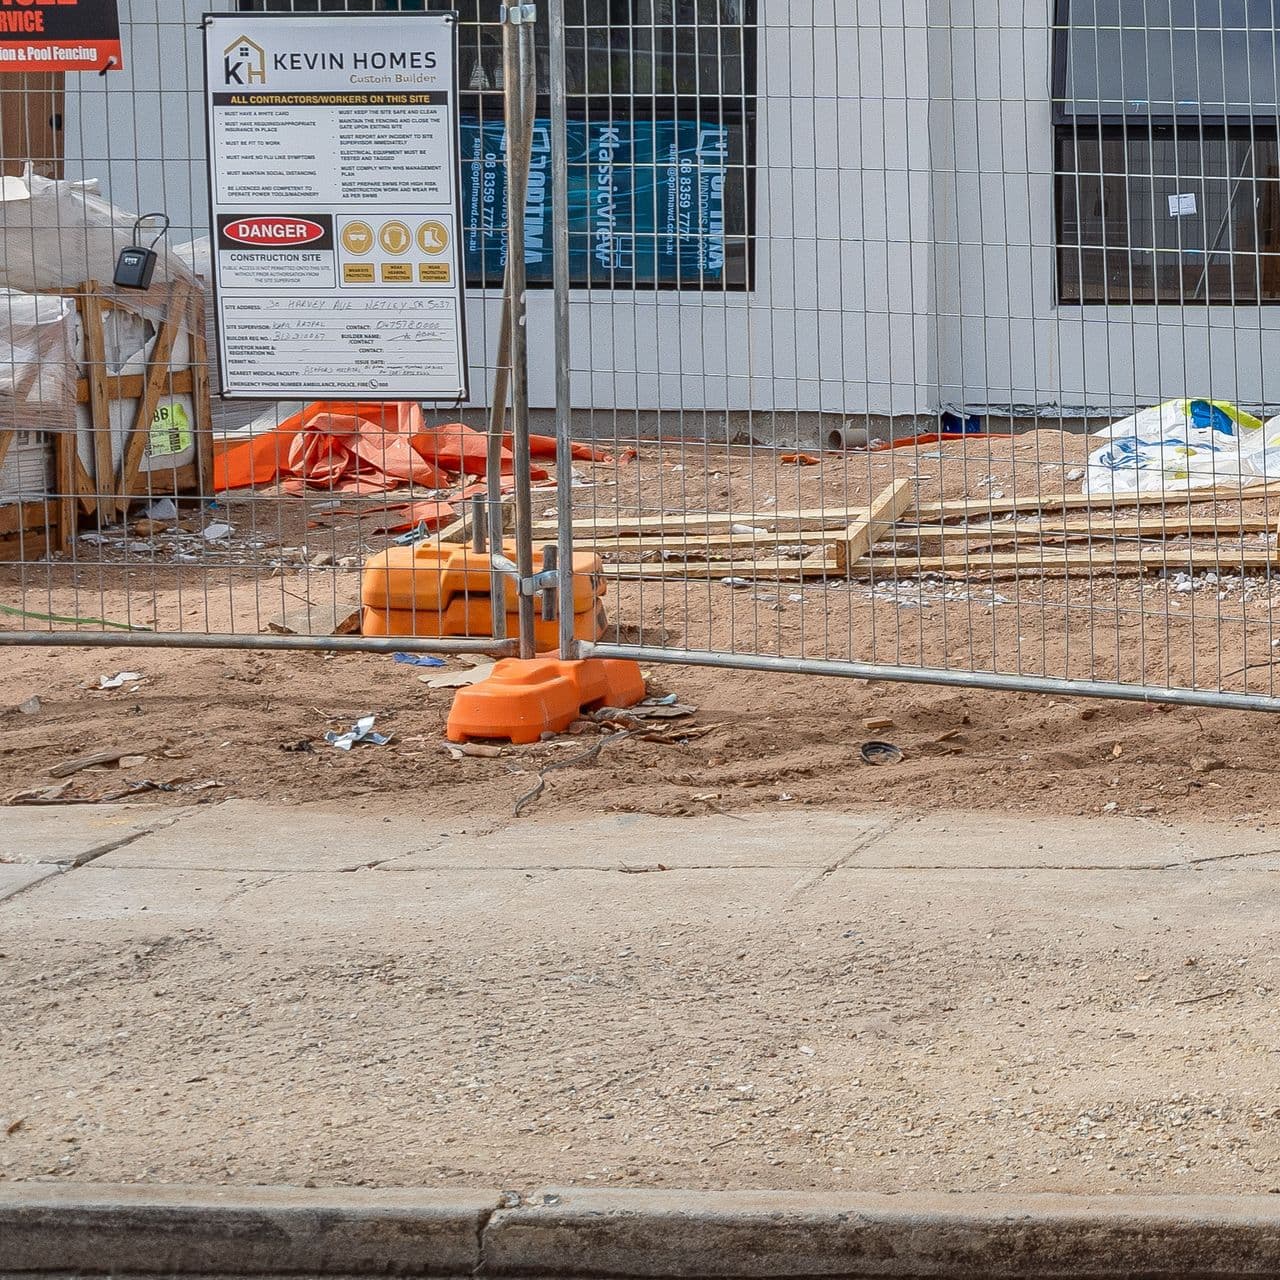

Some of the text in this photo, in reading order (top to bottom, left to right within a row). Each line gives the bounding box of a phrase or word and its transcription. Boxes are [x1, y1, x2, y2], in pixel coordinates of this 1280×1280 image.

[18, 47, 26, 62] &
[27, 46, 51, 62] Pool
[53, 46, 97, 63] Fencing
[273, 52, 437, 70] KEVIN HOMES
[350, 74, 437, 84] Custom Builder
[230, 95, 430, 104] ALL CONTRACTORS/WORKERS ON THIS SITE
[483, 153, 496, 238] 08 8359 7777
[595, 127, 620, 262] KlassicView
[678, 158, 692, 242] 08 8359 7777
[238, 223, 307, 238] DANGER
[230, 253, 322, 262] CONSTRUCTION SITE
